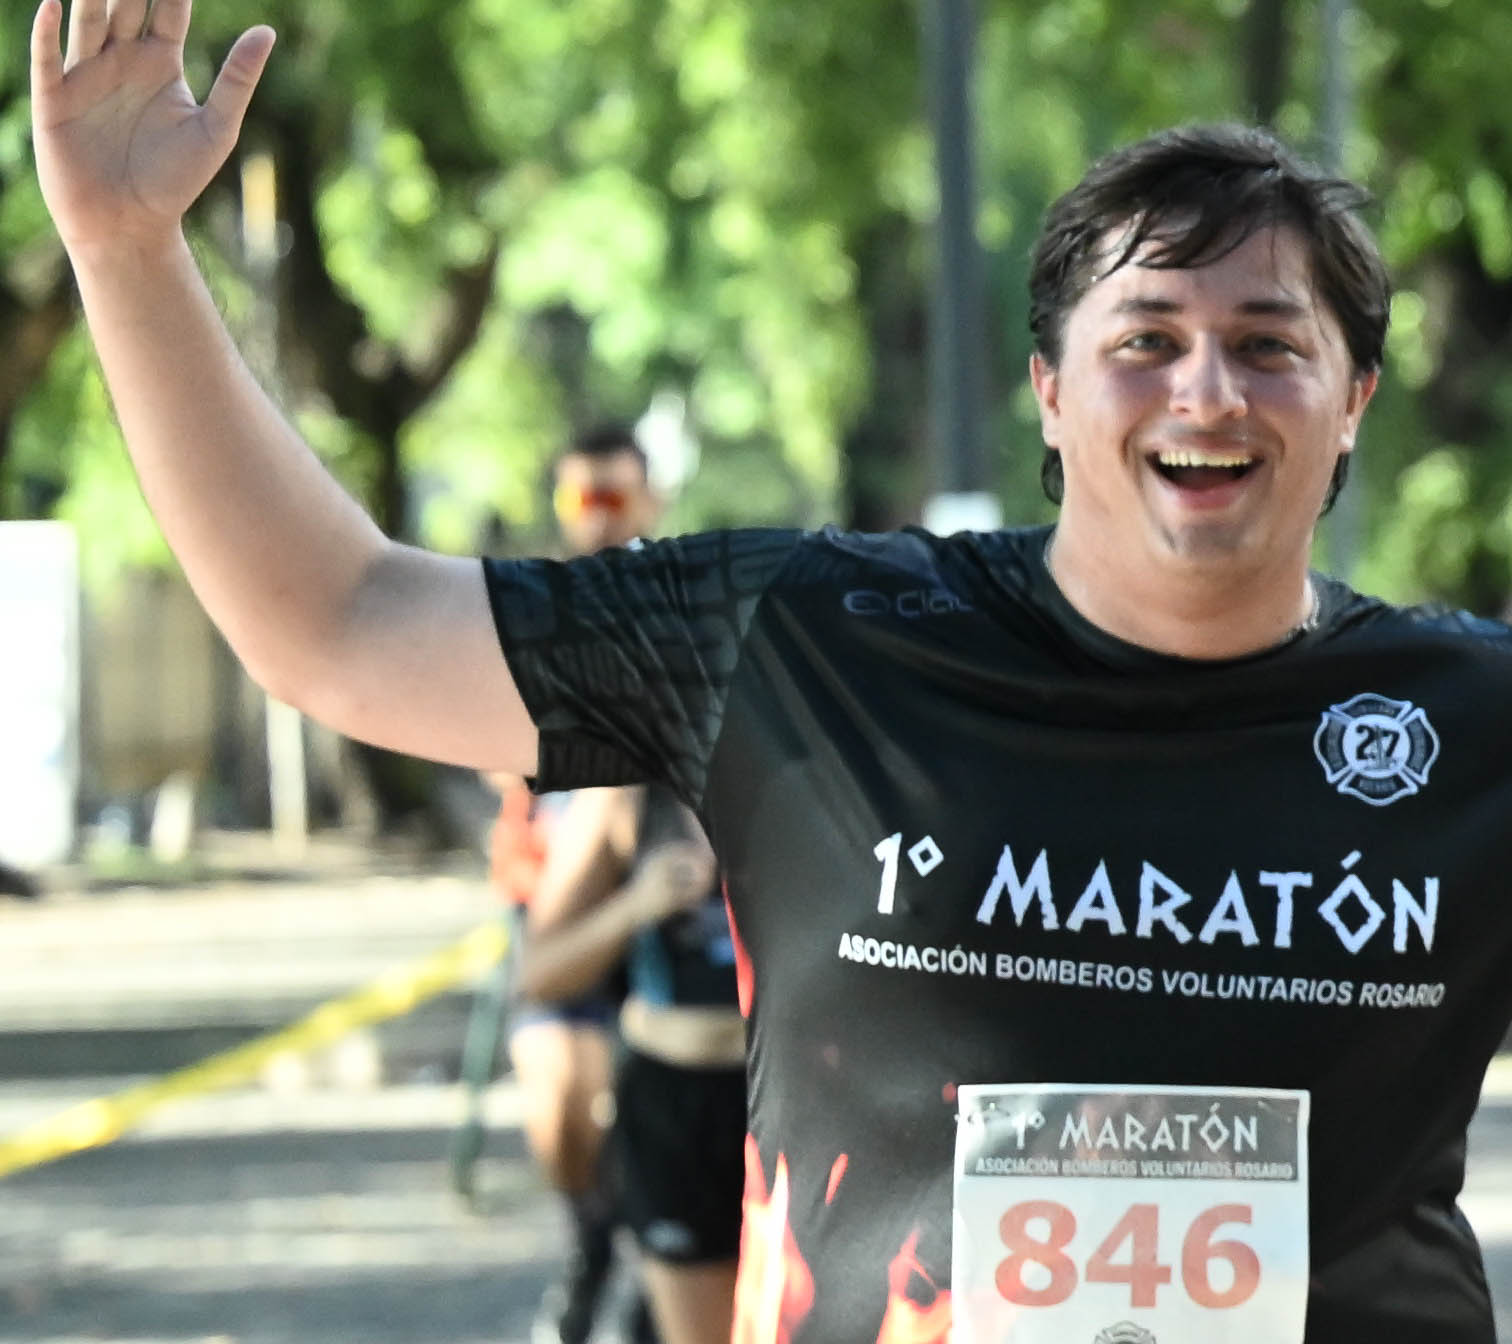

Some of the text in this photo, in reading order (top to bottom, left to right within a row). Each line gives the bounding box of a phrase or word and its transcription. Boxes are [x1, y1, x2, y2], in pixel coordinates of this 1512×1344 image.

[1355, 724, 1401, 760] 27
[976, 843, 1440, 955] MARATÓN
[838, 932, 988, 976] ASOCIACIÓN
[995, 953, 1154, 993] BOMBEROS
[1162, 969, 1353, 1007] VOLUNTARIOS
[1059, 1102, 1259, 1153] MARATÓN
[994, 1199, 1261, 1309] 846
